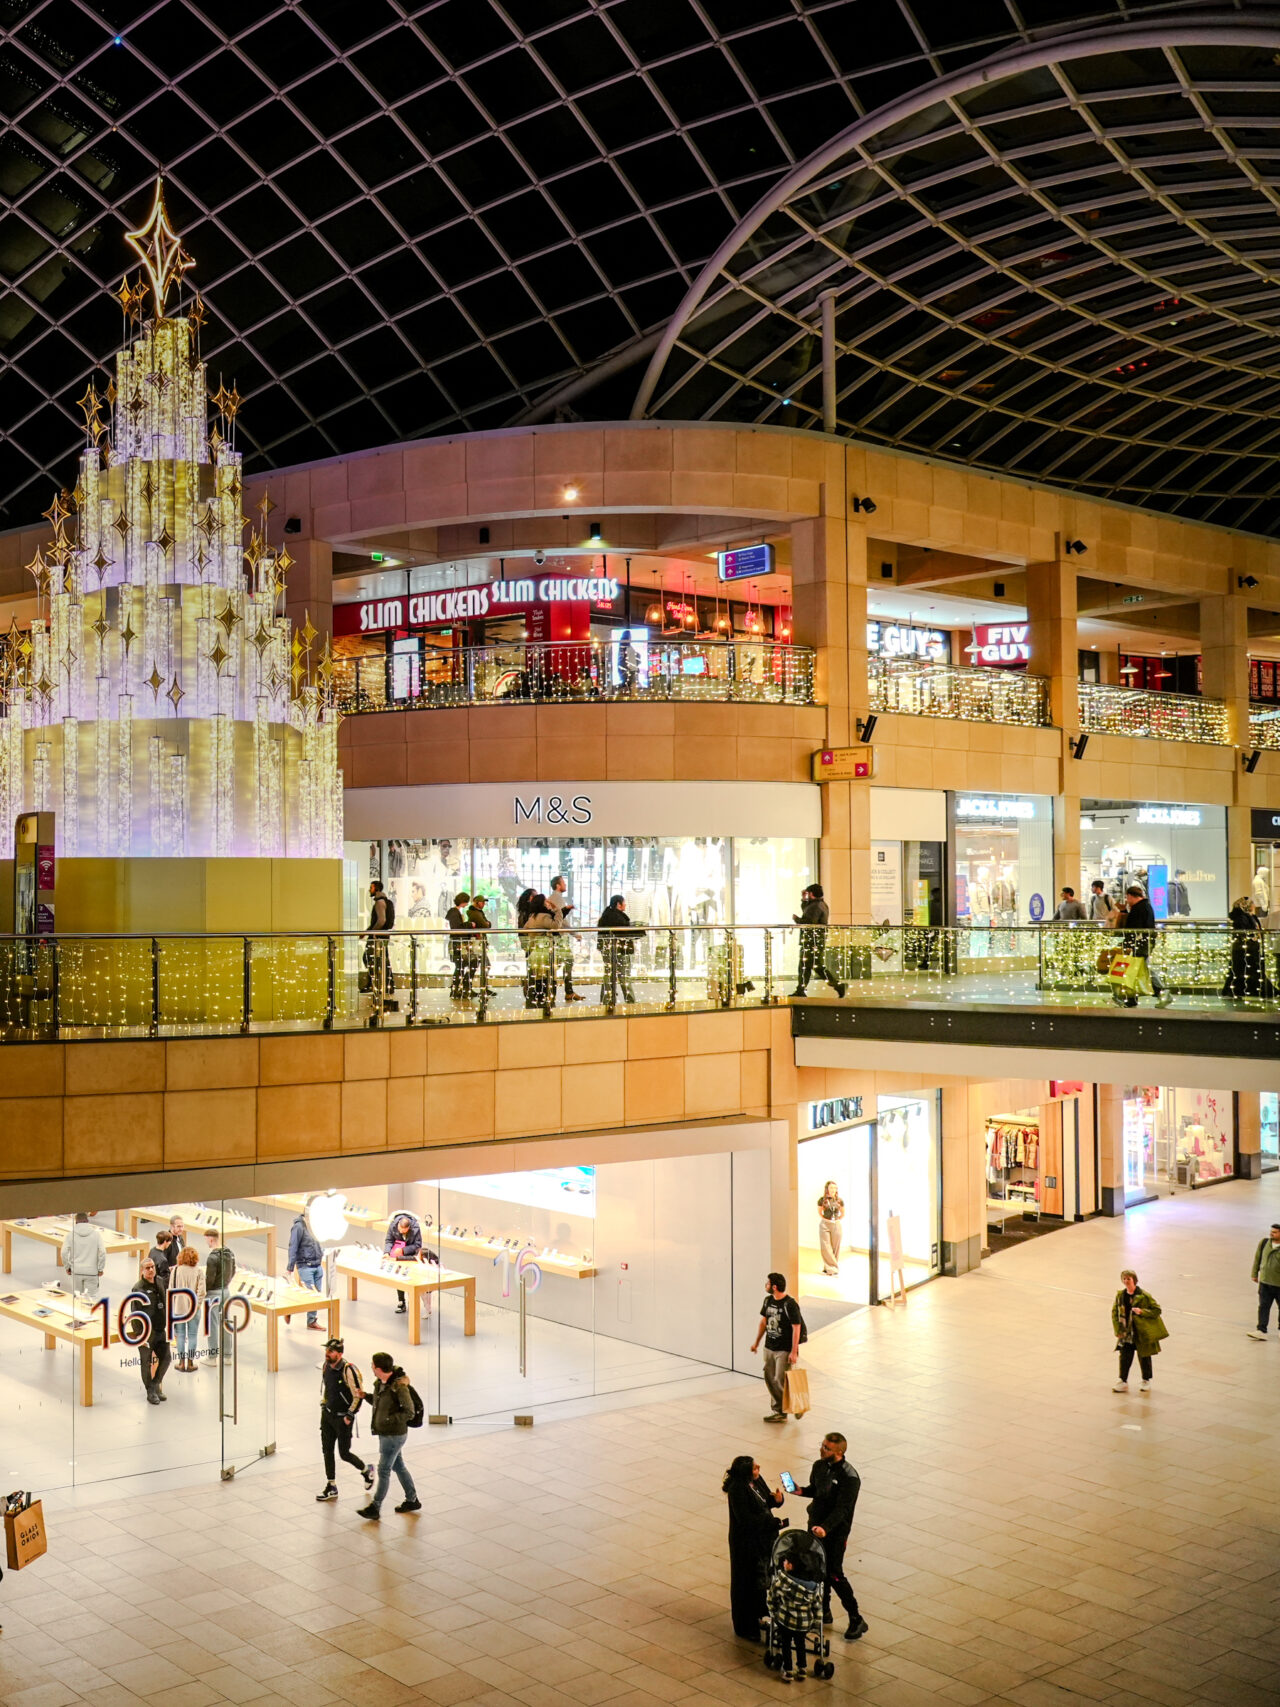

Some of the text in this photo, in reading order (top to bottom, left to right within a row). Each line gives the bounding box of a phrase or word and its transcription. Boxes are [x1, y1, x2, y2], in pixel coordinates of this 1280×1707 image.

[491, 578, 619, 602] SLIM CHICKENS
[360, 587, 489, 631] SLIM CHICKENS
[884, 626, 945, 658] GUYS
[988, 626, 1029, 644] FIV
[982, 644, 1030, 661] GUY
[514, 796, 591, 824] M&S
[812, 1096, 863, 1129] LOUNGE
[494, 1246, 541, 1297] 16
[91, 1287, 252, 1350] 16 Pro
[172, 1347, 220, 1361] Intelligence
[20, 1523, 38, 1539] GLASS
[21, 1531, 40, 1546] ONION
